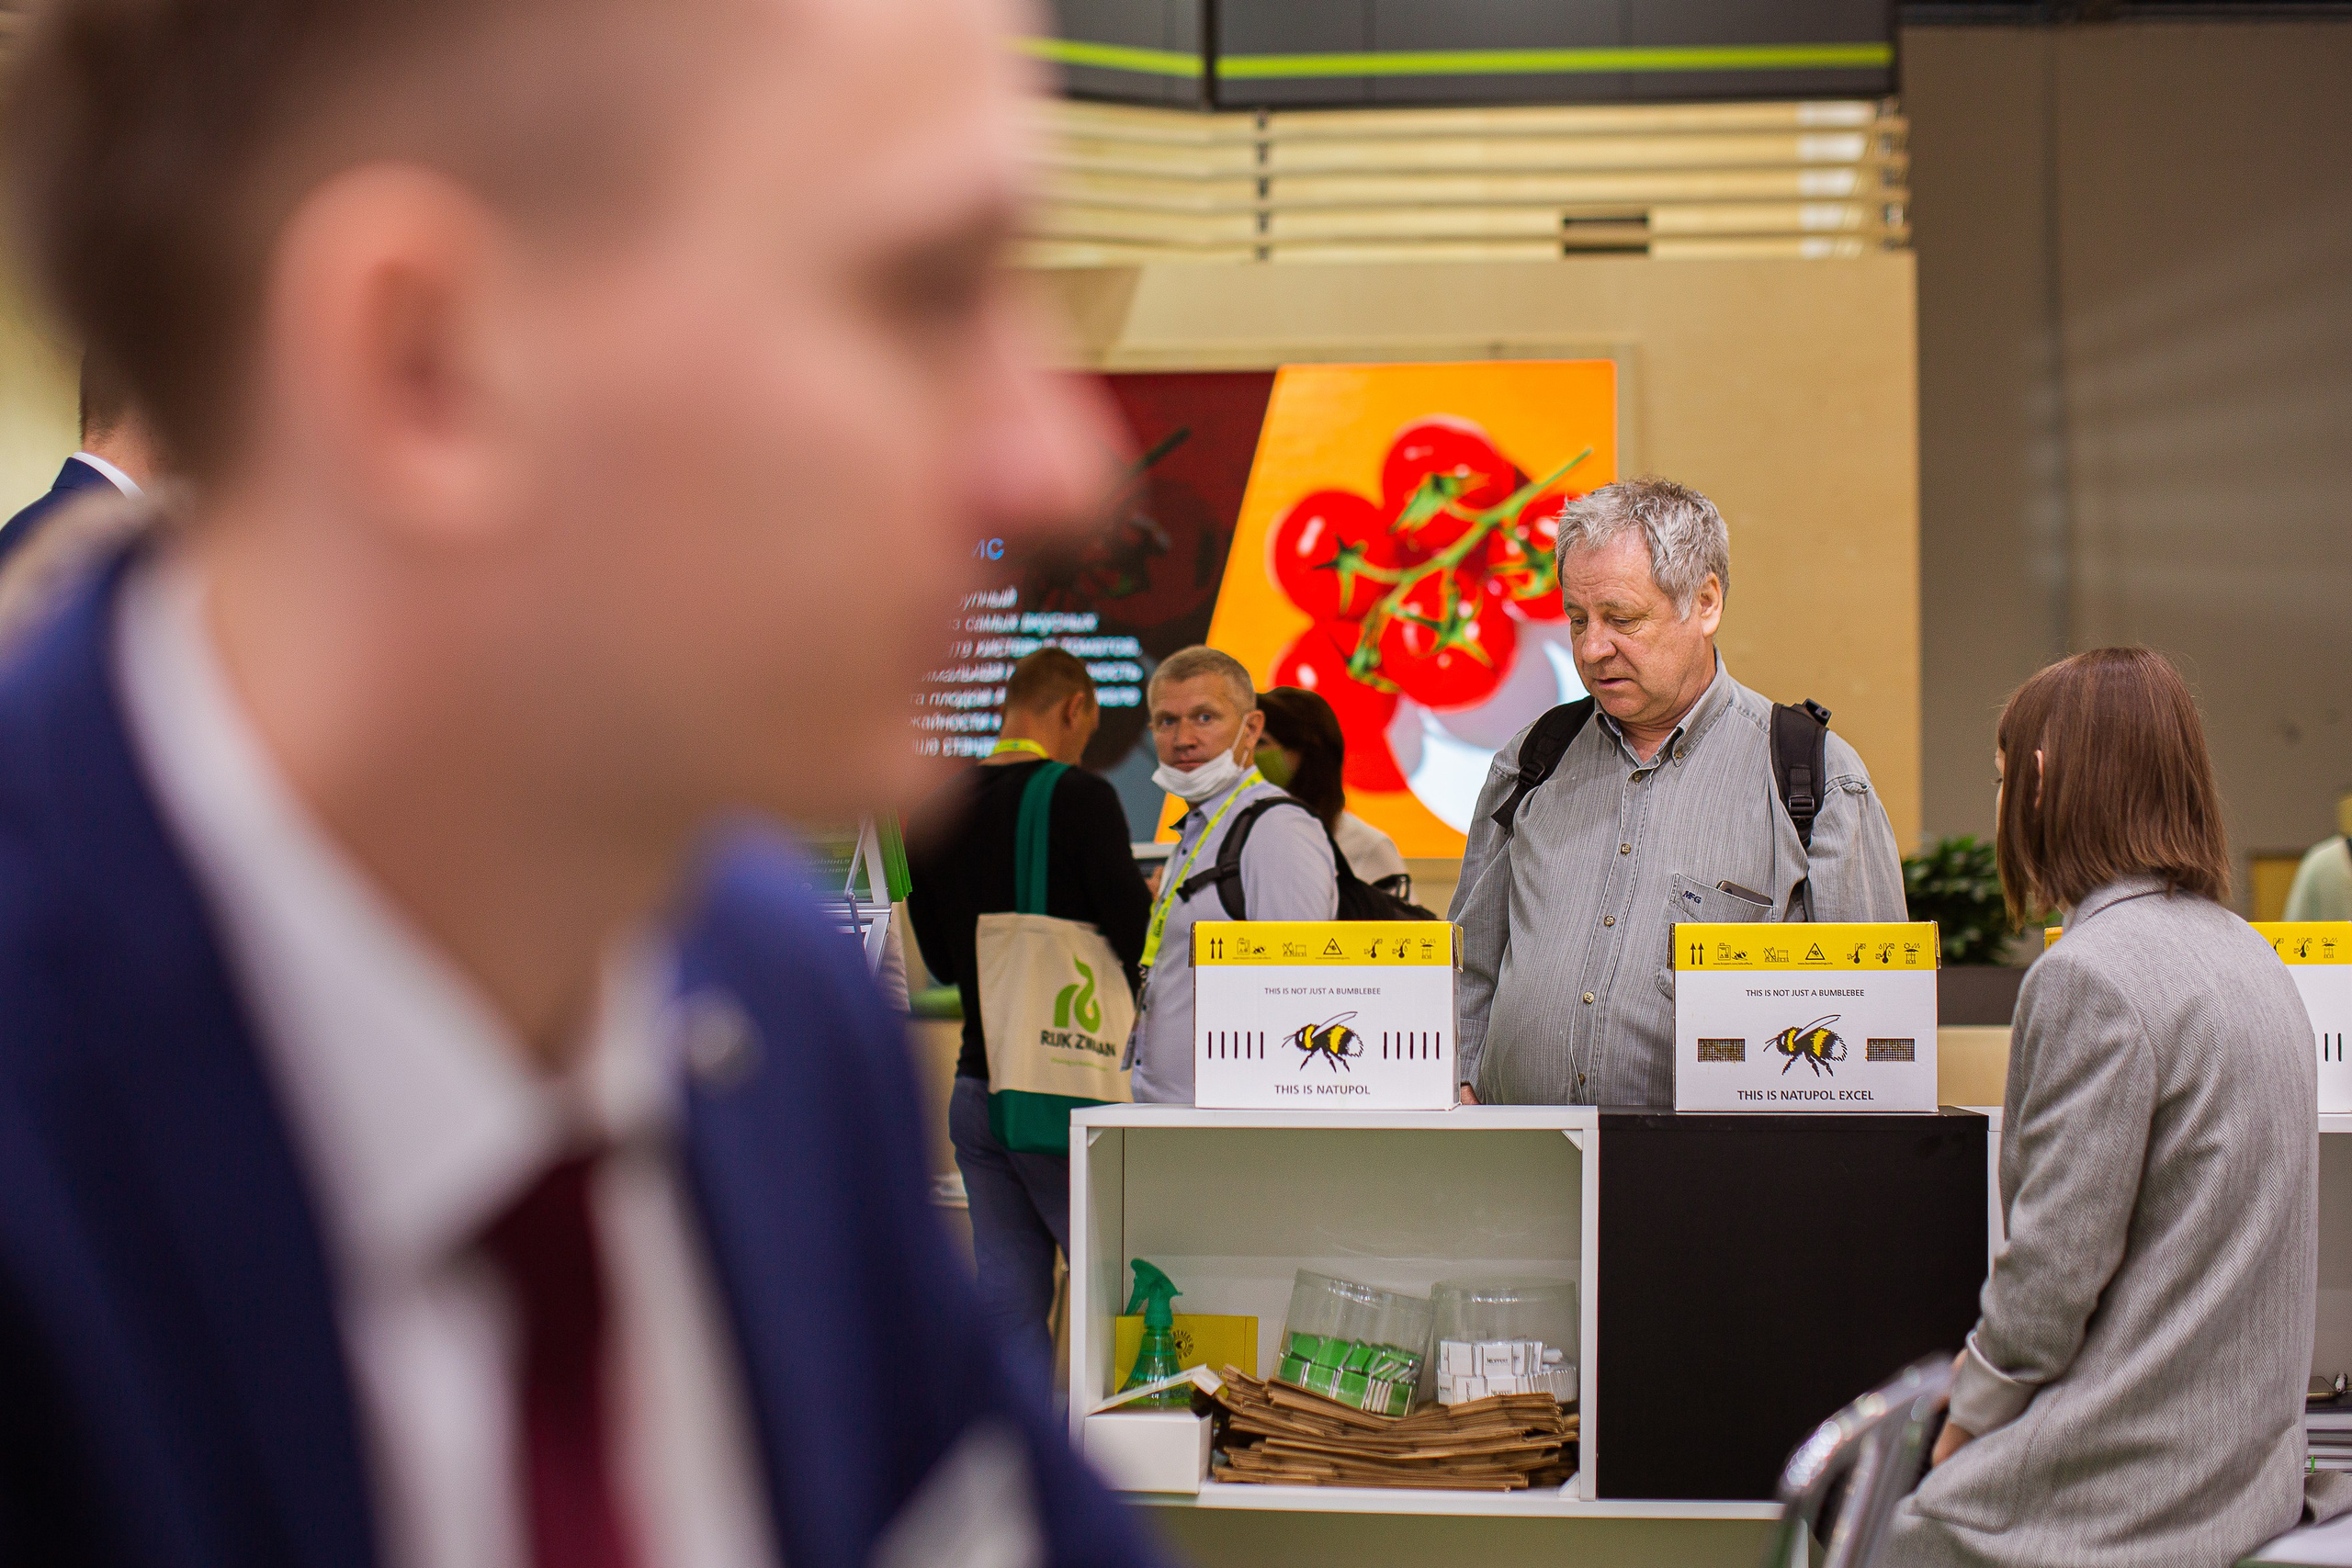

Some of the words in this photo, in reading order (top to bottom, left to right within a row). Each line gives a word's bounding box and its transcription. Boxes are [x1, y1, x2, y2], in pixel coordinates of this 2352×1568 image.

[1792, 989, 1809, 998] JUST
[1274, 1084, 1300, 1095] THIS
[1303, 1085, 1313, 1095] IS
[1317, 1085, 1371, 1095] NATUPOL
[1737, 1089, 1764, 1100] THIS
[1767, 1090, 1778, 1100] IS
[1781, 1090, 1836, 1100] NATUPOL
[1838, 1090, 1874, 1100] EXCEL
